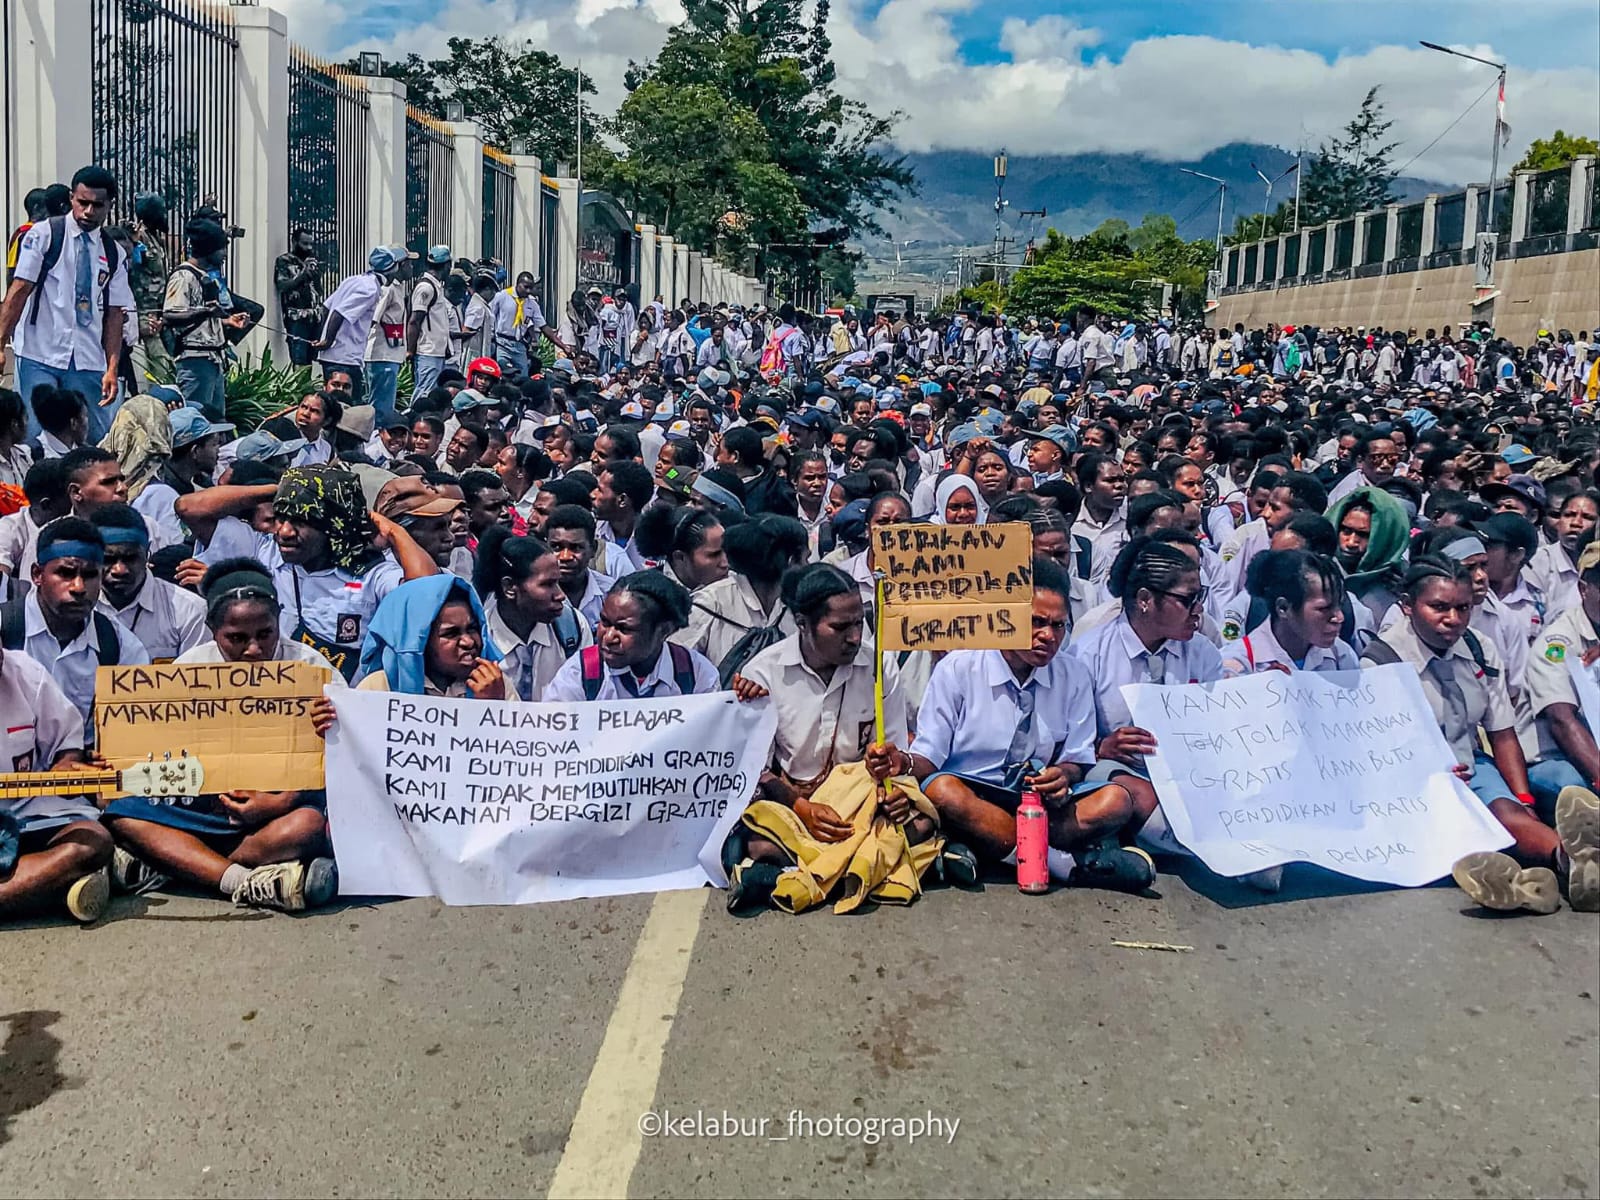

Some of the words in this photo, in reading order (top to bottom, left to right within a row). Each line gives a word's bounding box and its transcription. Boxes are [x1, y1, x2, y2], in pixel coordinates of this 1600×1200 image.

[880, 528, 1005, 552] BERIKAN
[901, 608, 1016, 646] GRATIS
[240, 696, 307, 717] GRATIS
[1160, 691, 1248, 719] KAMI
[1265, 679, 1322, 710] SMK
[387, 699, 459, 727] FRON
[479, 707, 580, 731] ALIANSI
[598, 708, 685, 731] PELAJAR
[386, 727, 436, 746] DAN
[450, 737, 581, 757] MAHASISWA
[1230, 719, 1313, 757] TOLAK
[1320, 711, 1413, 744] MAKANAN
[386, 747, 451, 773] KAMI
[468, 757, 543, 777] BUTUH
[554, 753, 654, 778] PENDIDIKAN
[664, 750, 735, 769] GRATIS
[1189, 760, 1293, 793] GRATIS
[1314, 754, 1365, 782] KAMI
[385, 773, 446, 800] KAMI
[465, 783, 534, 804] TIDAK
[541, 776, 687, 801] MEMBUTUHKAN
[692, 770, 748, 799] (MBG)
[394, 802, 511, 825] MAKANAN
[530, 802, 632, 822] BERGIZI
[647, 799, 728, 824] GRATIS
[1349, 796, 1430, 818] GRATIS
